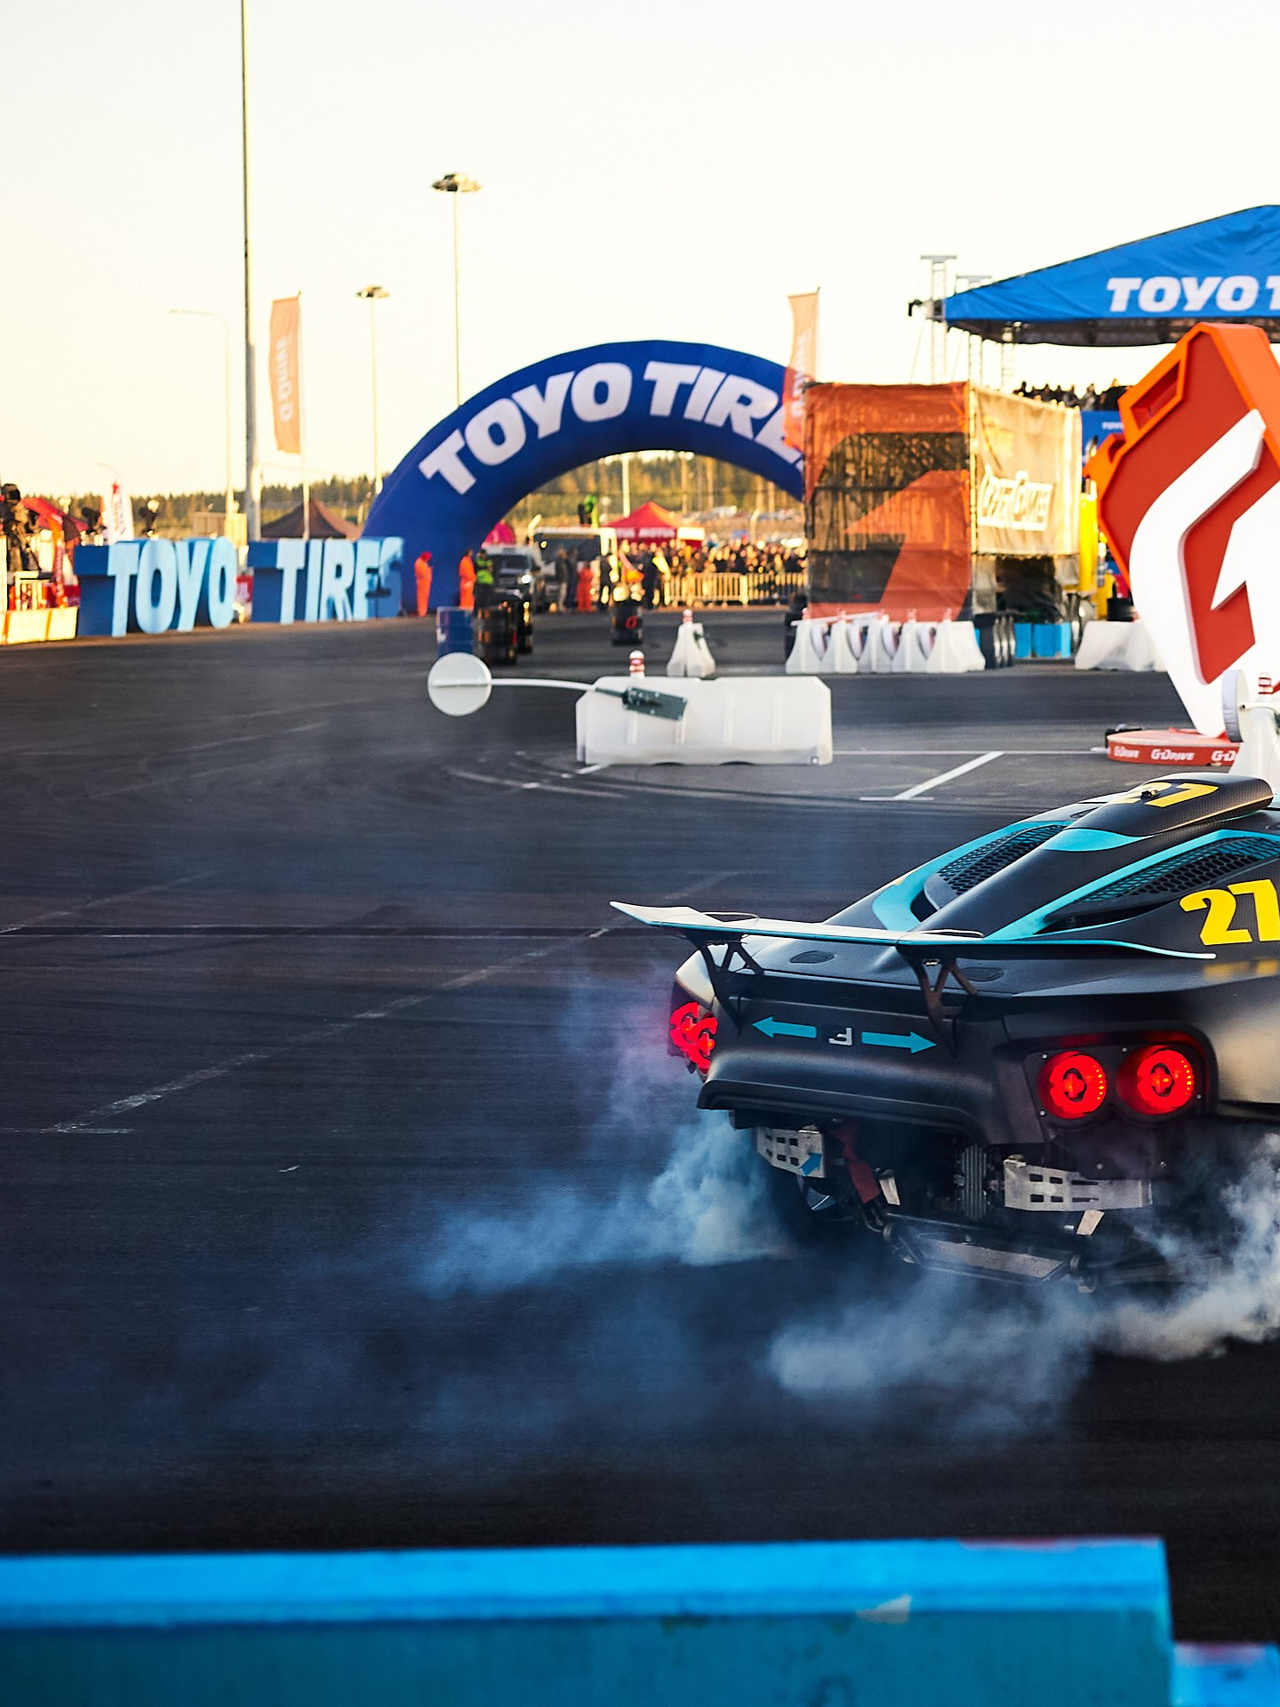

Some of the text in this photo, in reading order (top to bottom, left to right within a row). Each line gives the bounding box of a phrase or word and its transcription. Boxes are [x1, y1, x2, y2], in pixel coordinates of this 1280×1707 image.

[1106, 276, 1259, 312] TOYO
[418, 362, 632, 495] TOYO
[643, 360, 804, 473] TIR
[107, 536, 237, 638] TOYO
